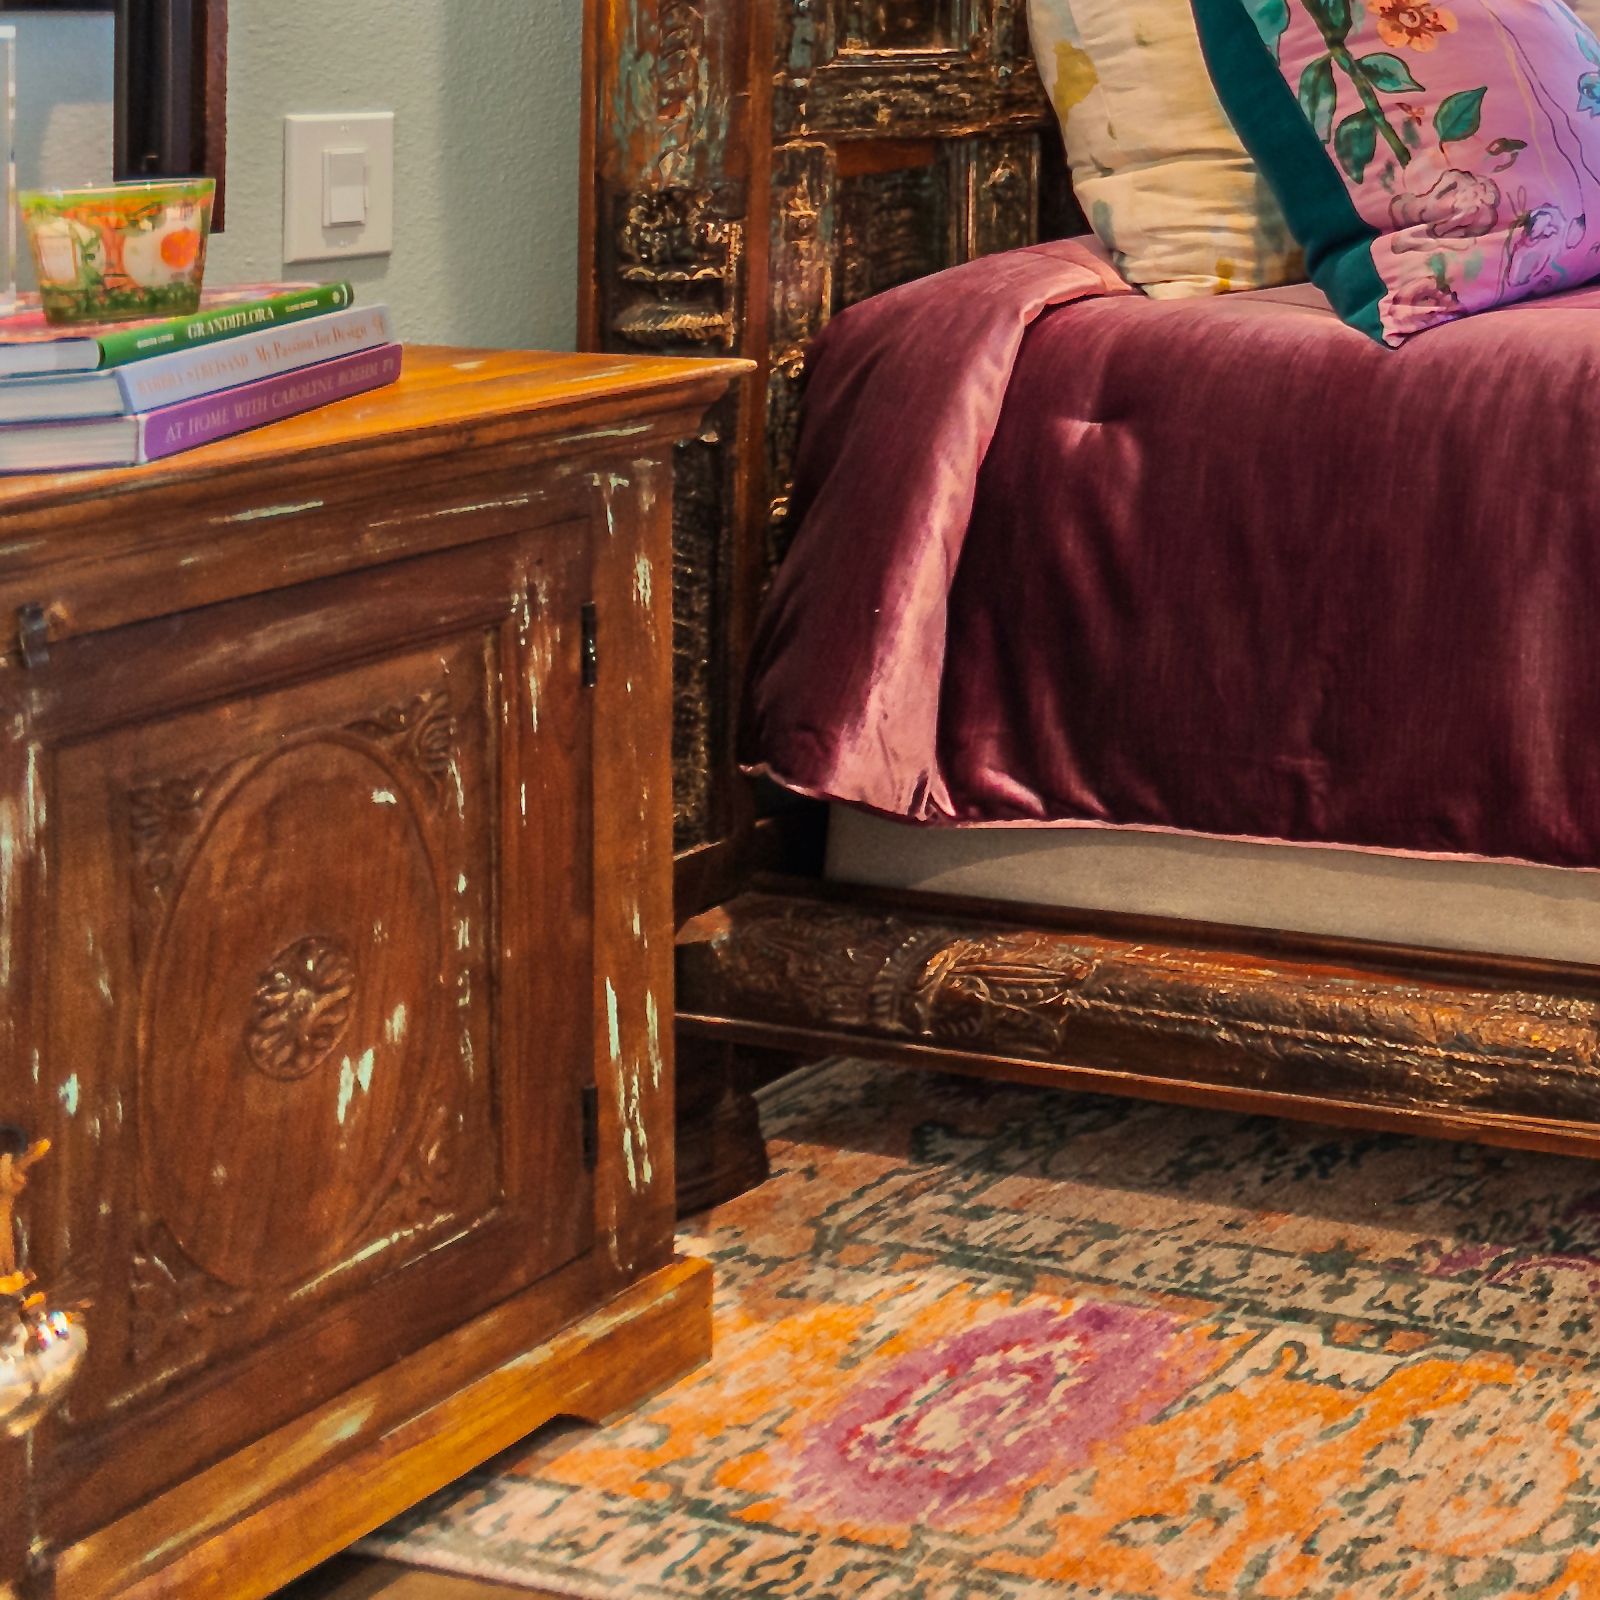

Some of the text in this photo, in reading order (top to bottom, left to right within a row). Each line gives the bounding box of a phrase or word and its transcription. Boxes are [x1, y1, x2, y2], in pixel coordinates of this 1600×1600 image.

[166, 422, 185, 444] AT
[188, 407, 230, 437] HOME
[234, 394, 268, 420] WITH
